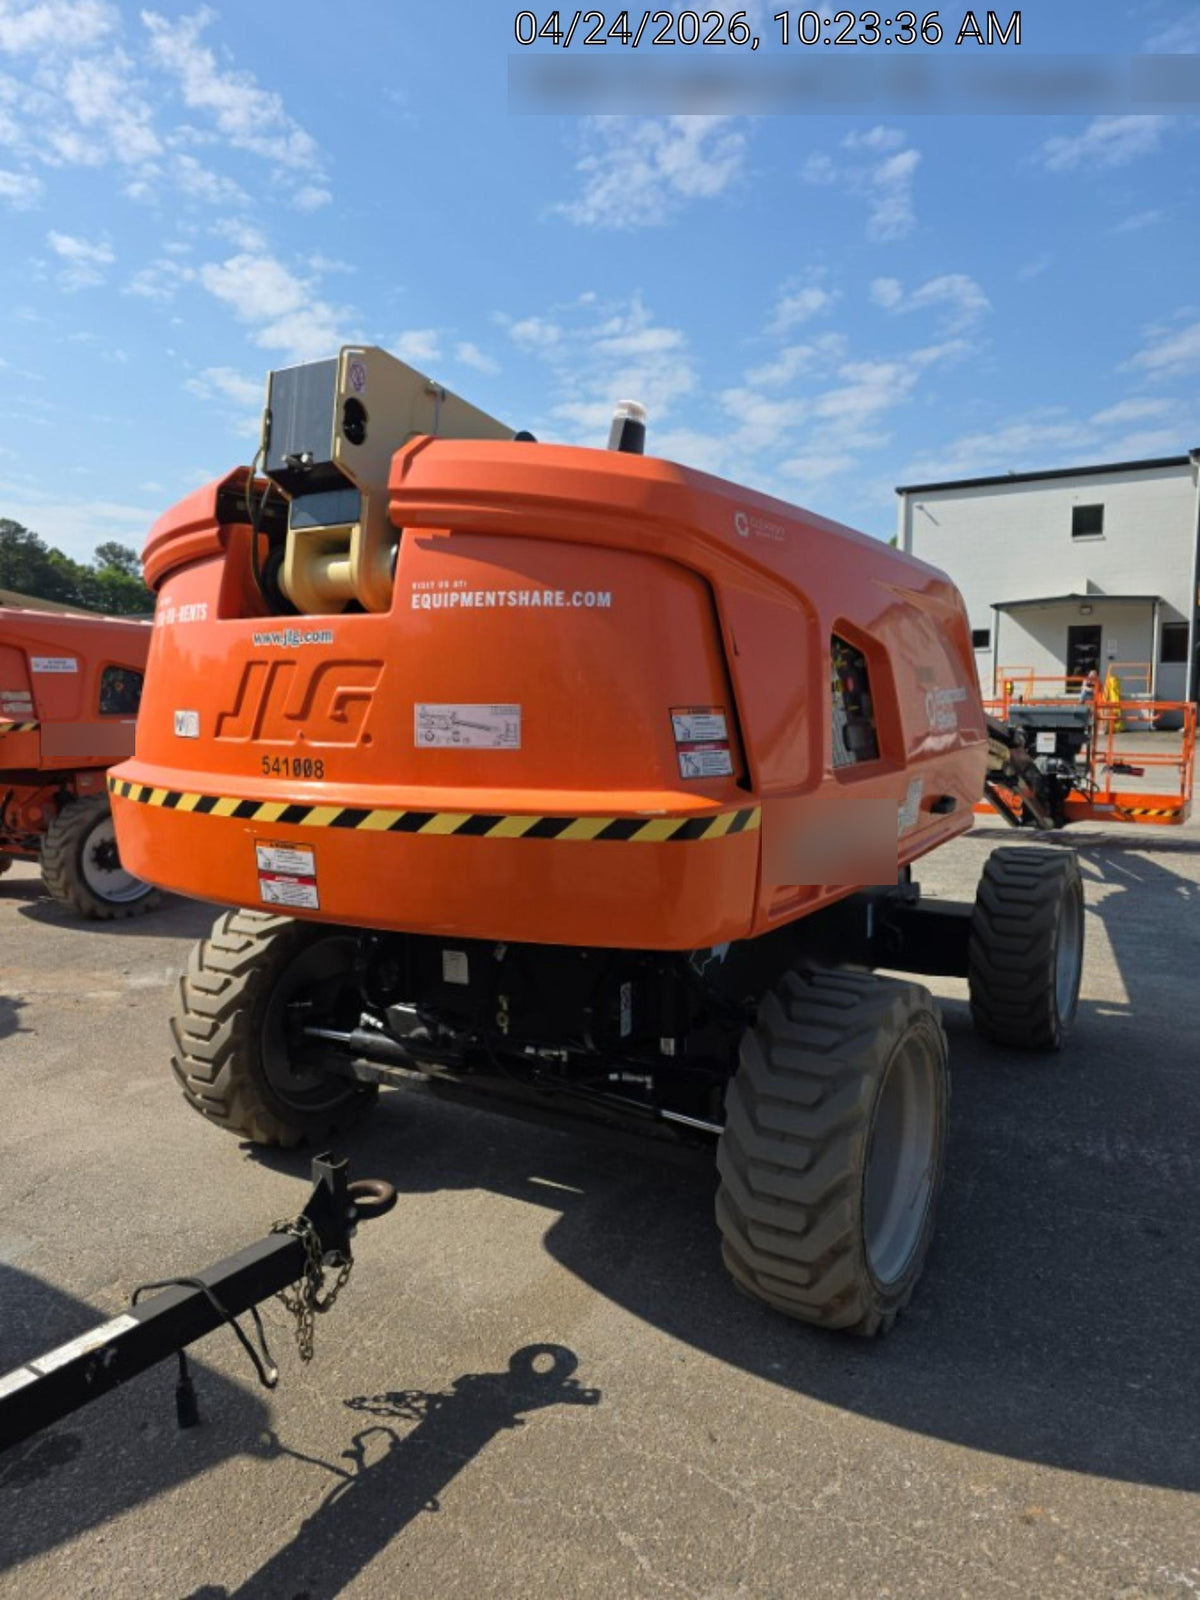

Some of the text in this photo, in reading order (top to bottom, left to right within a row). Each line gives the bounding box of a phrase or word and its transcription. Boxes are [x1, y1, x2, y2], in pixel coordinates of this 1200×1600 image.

[411, 591, 612, 610] EQUIPMENTSHARE.COM
[252, 629, 333, 648] www.jlg.com
[214, 659, 386, 748] JLG
[261, 755, 325, 780] 541008
